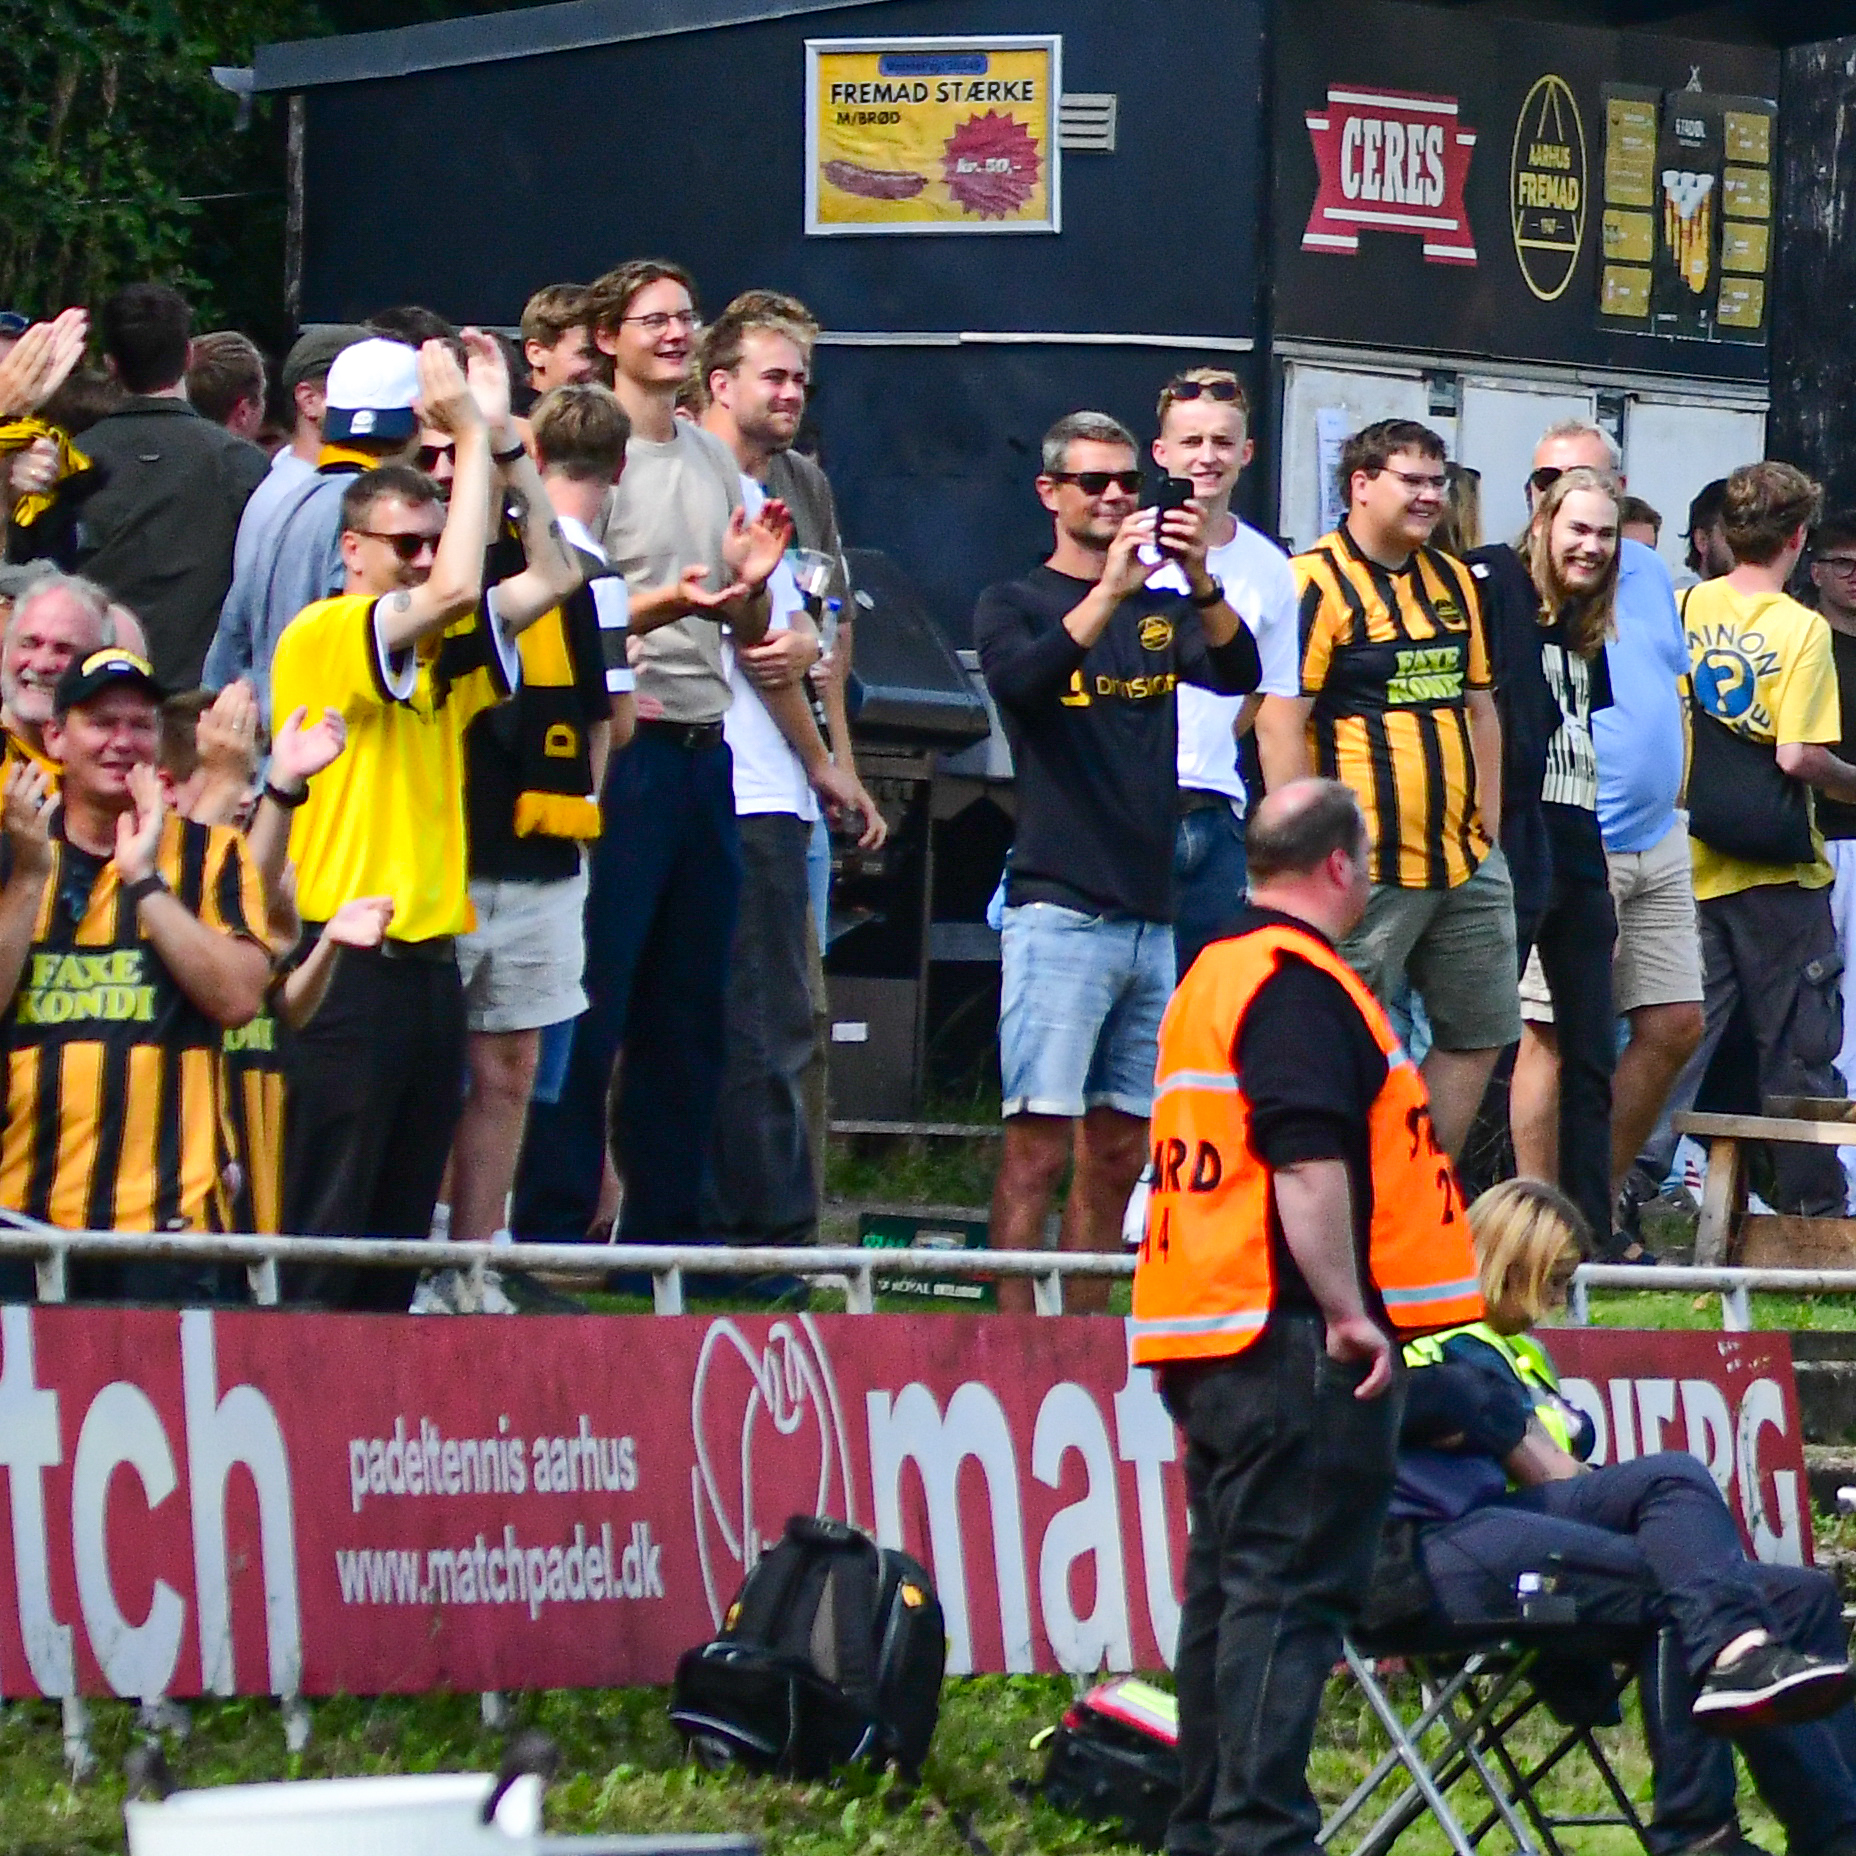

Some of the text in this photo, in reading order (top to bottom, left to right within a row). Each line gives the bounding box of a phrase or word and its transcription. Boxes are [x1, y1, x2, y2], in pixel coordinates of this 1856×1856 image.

[830, 80, 1034, 106] FREMAD STÆRKE
[836, 111, 901, 126] M/BRØD
[1340, 116, 1446, 208] CERES
[1528, 143, 1570, 170] AARHUS
[1518, 172, 1580, 211] FREMAD
[32, 950, 142, 988] FAXE
[16, 987, 156, 1025] KONDI
[349, 1414, 638, 1513] padeltennis aarhus
[336, 1522, 664, 1621] www.matchpadel.dk
